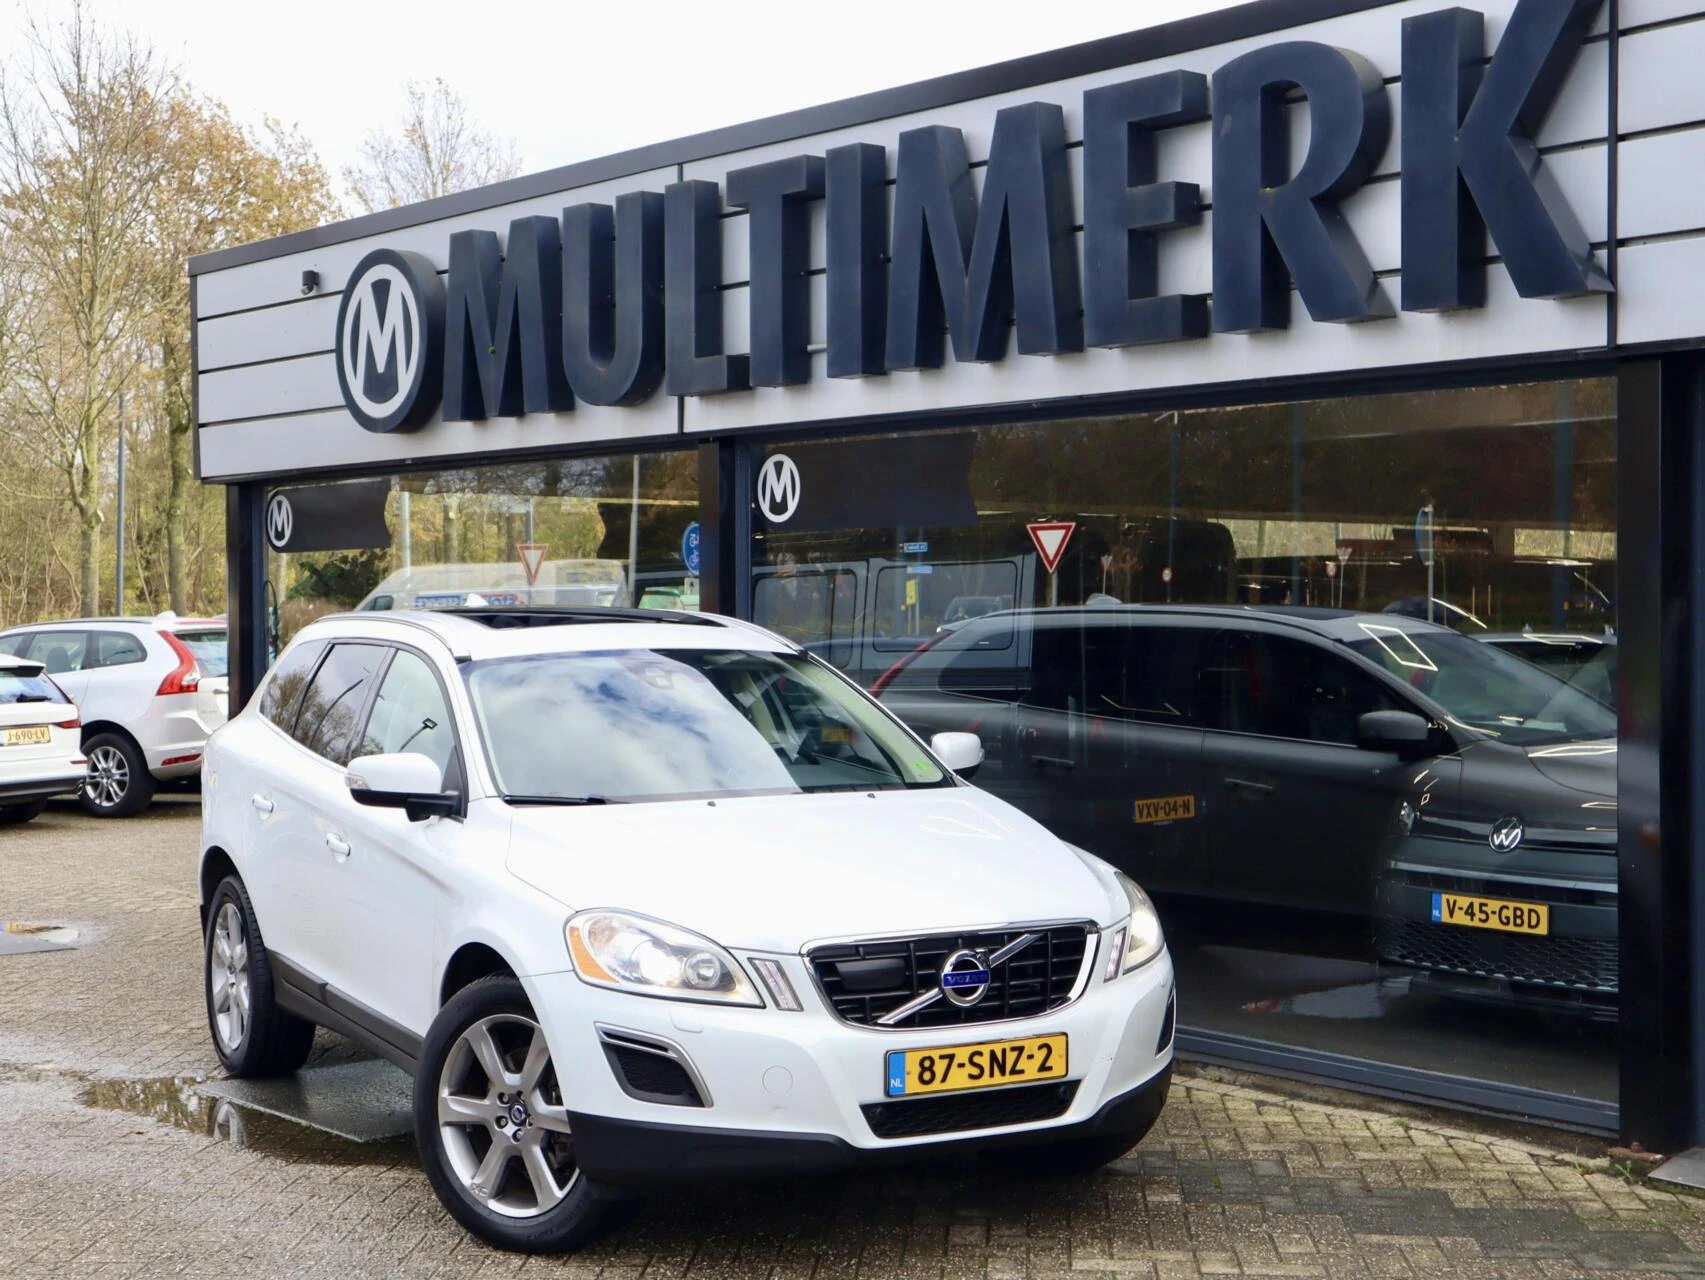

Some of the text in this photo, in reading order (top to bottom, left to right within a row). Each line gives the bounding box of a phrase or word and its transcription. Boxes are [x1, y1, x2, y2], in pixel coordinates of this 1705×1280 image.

[343, 0, 1612, 421] M MULTIMERK
[758, 454, 800, 522] M
[268, 495, 292, 546] M
[8, 729, 45, 742] J-690-LV
[1445, 898, 1541, 930] V-45-GBD
[890, 1042, 1054, 1088] NL 87-SNZ-2
